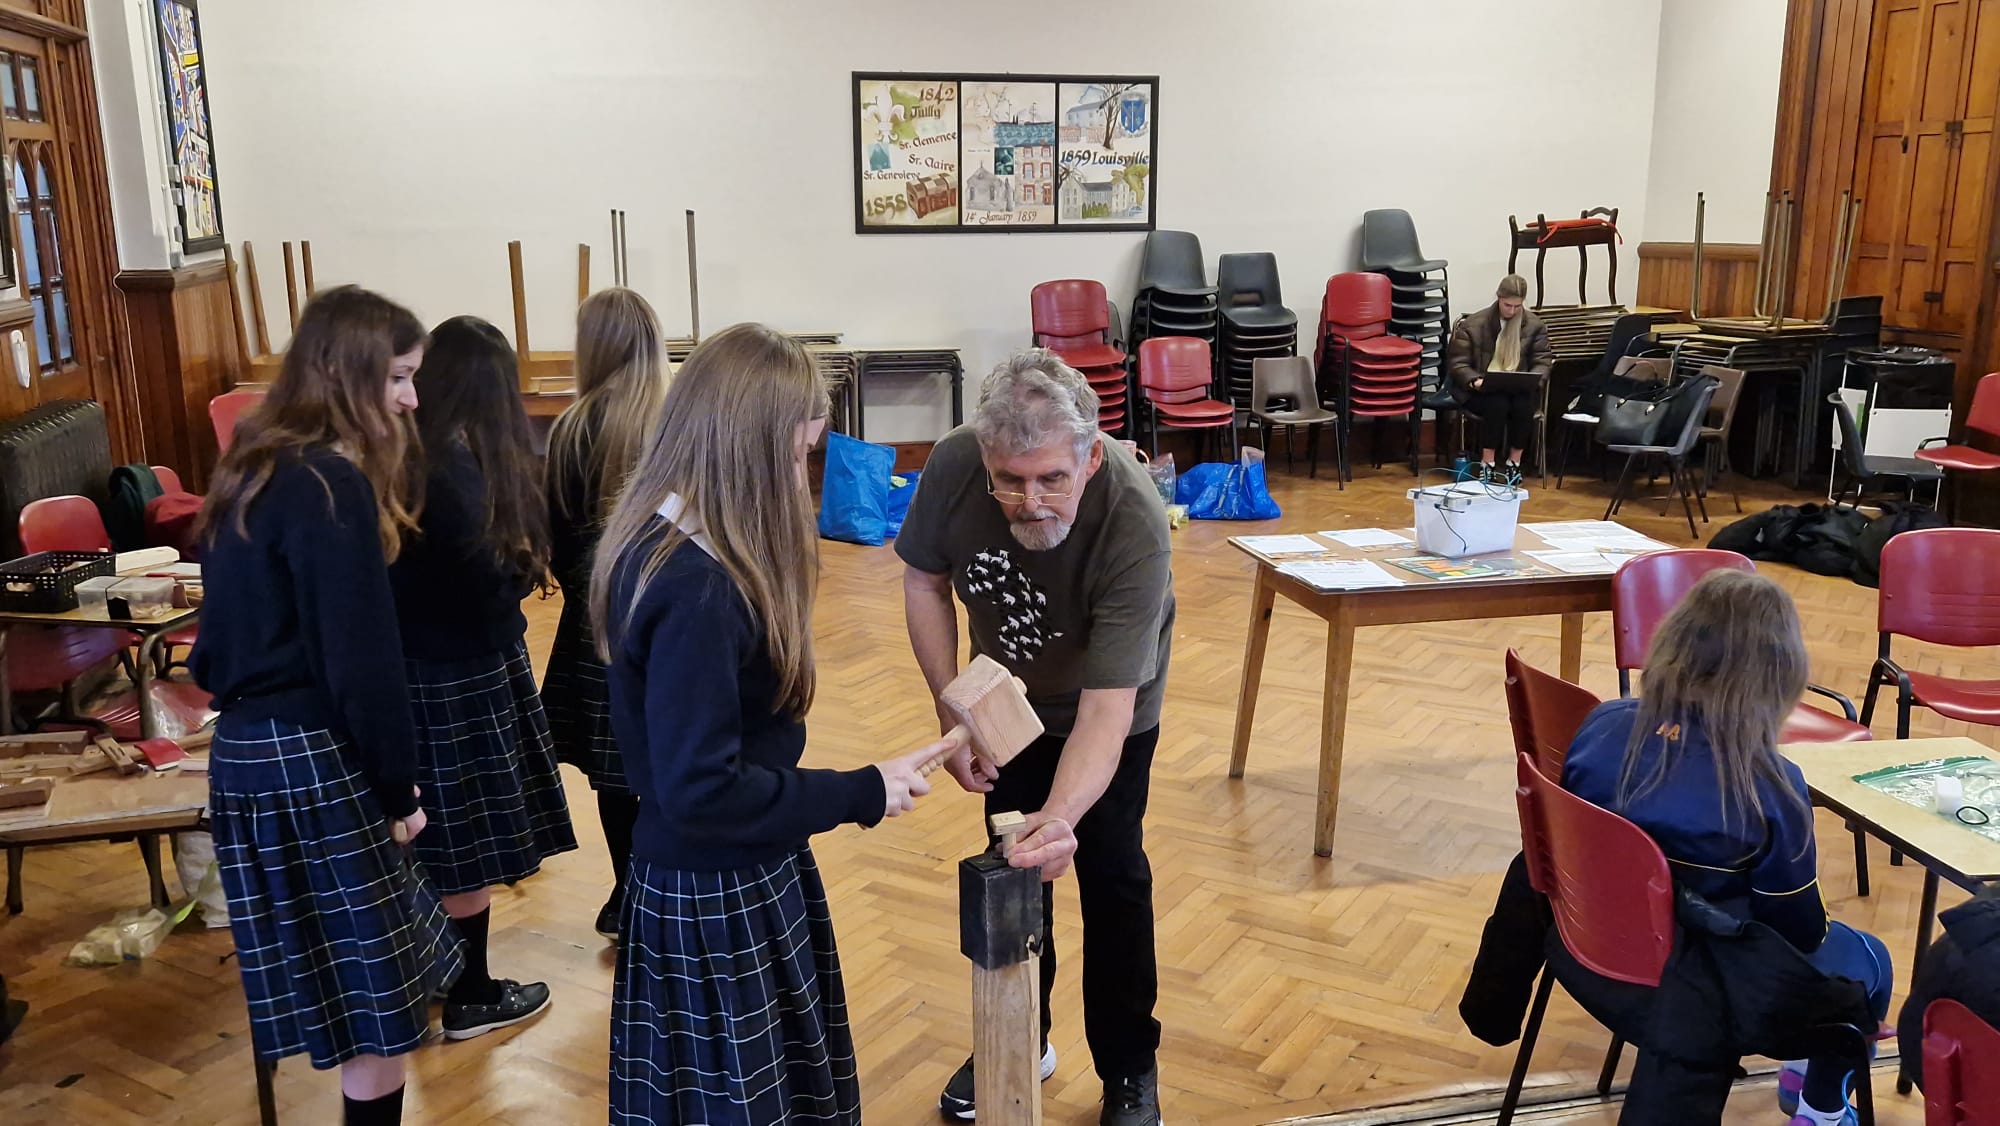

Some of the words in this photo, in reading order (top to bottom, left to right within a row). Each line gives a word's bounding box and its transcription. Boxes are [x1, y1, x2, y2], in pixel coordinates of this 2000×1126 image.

[920, 83, 954, 104] 1842
[900, 141, 912, 150] Sr.
[913, 132, 957, 147] Clemence
[909, 154, 922, 166] Sr.
[925, 157, 955, 172] Claire
[1060, 150, 1092, 167] 1859
[1092, 151, 1150, 166] Louisville
[866, 194, 907, 219] 1858
[1018, 210, 1038, 223] 1859
